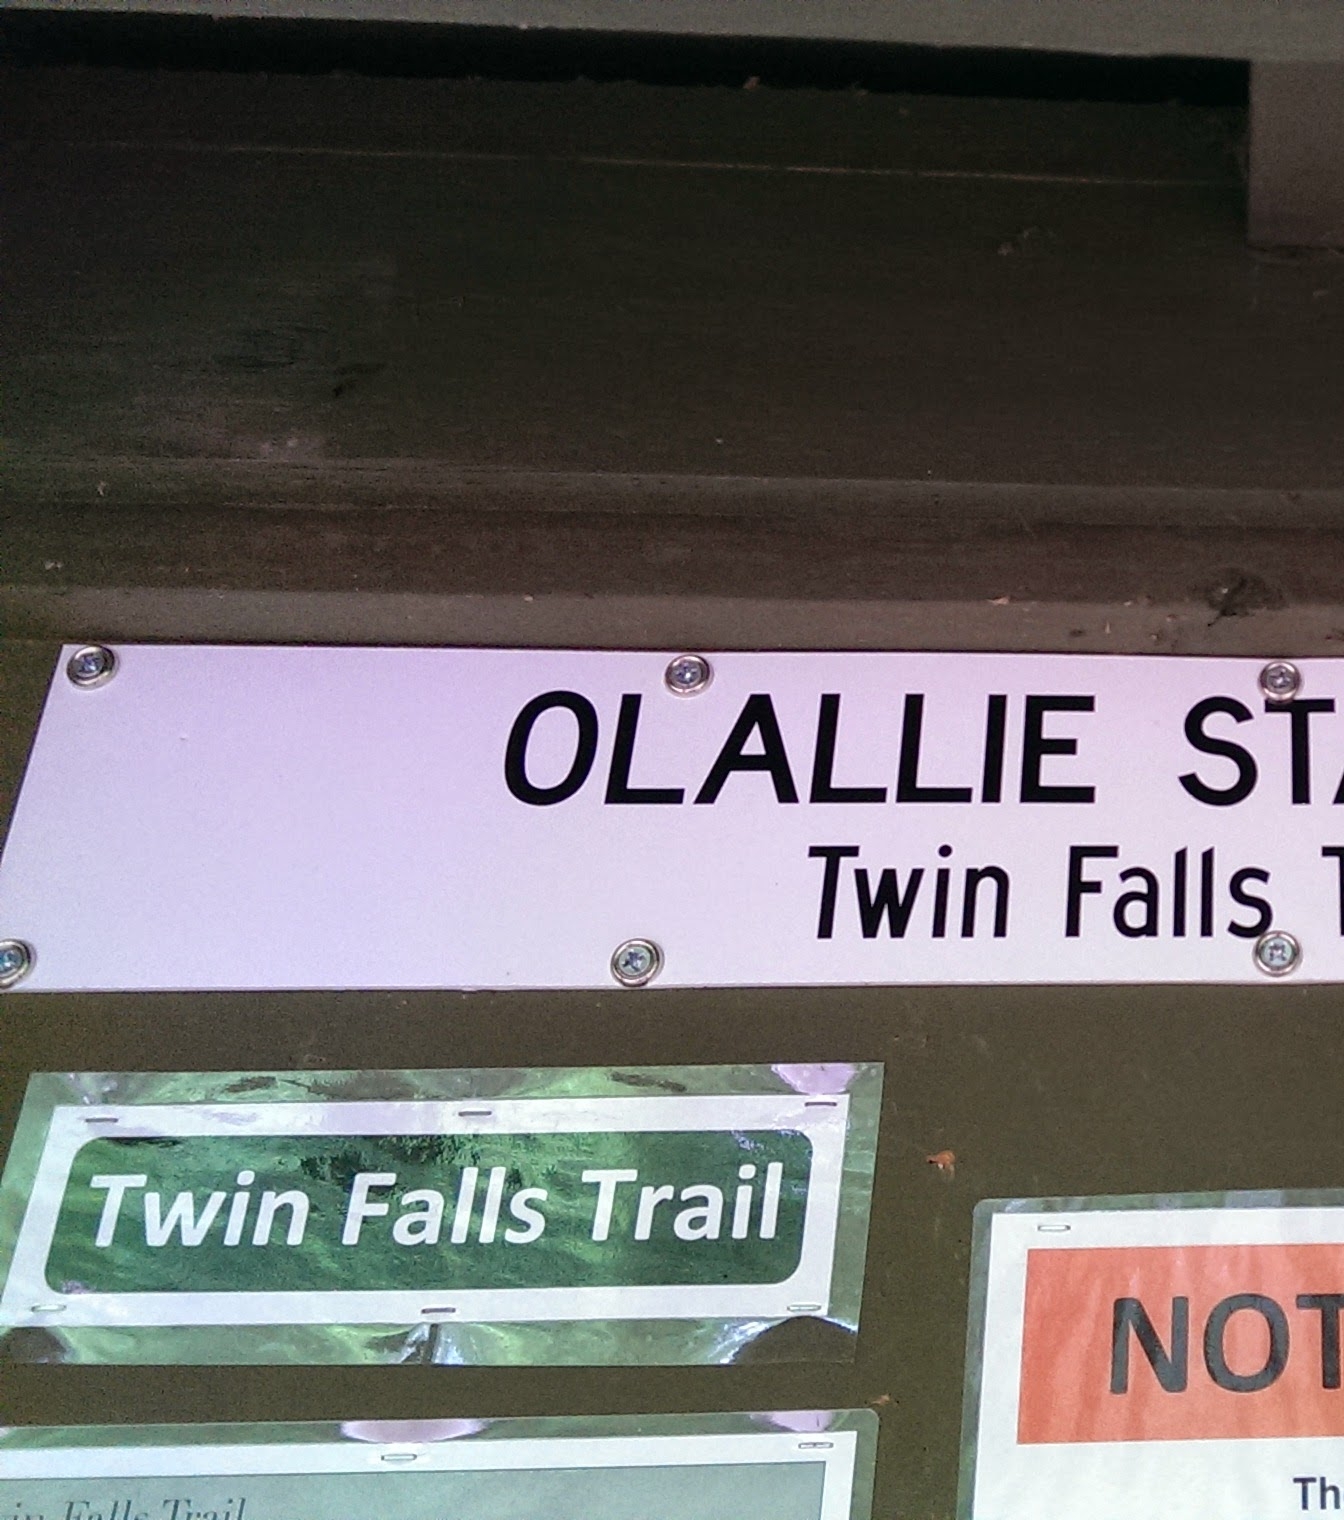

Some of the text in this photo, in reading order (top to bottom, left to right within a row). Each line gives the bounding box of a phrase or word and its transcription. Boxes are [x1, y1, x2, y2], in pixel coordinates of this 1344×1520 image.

[502, 690, 1097, 807] OLALLIE
[808, 844, 1010, 939] Twin
[1064, 844, 1274, 939] Falls
[89, 1161, 785, 1248] Twin Falls Trail
